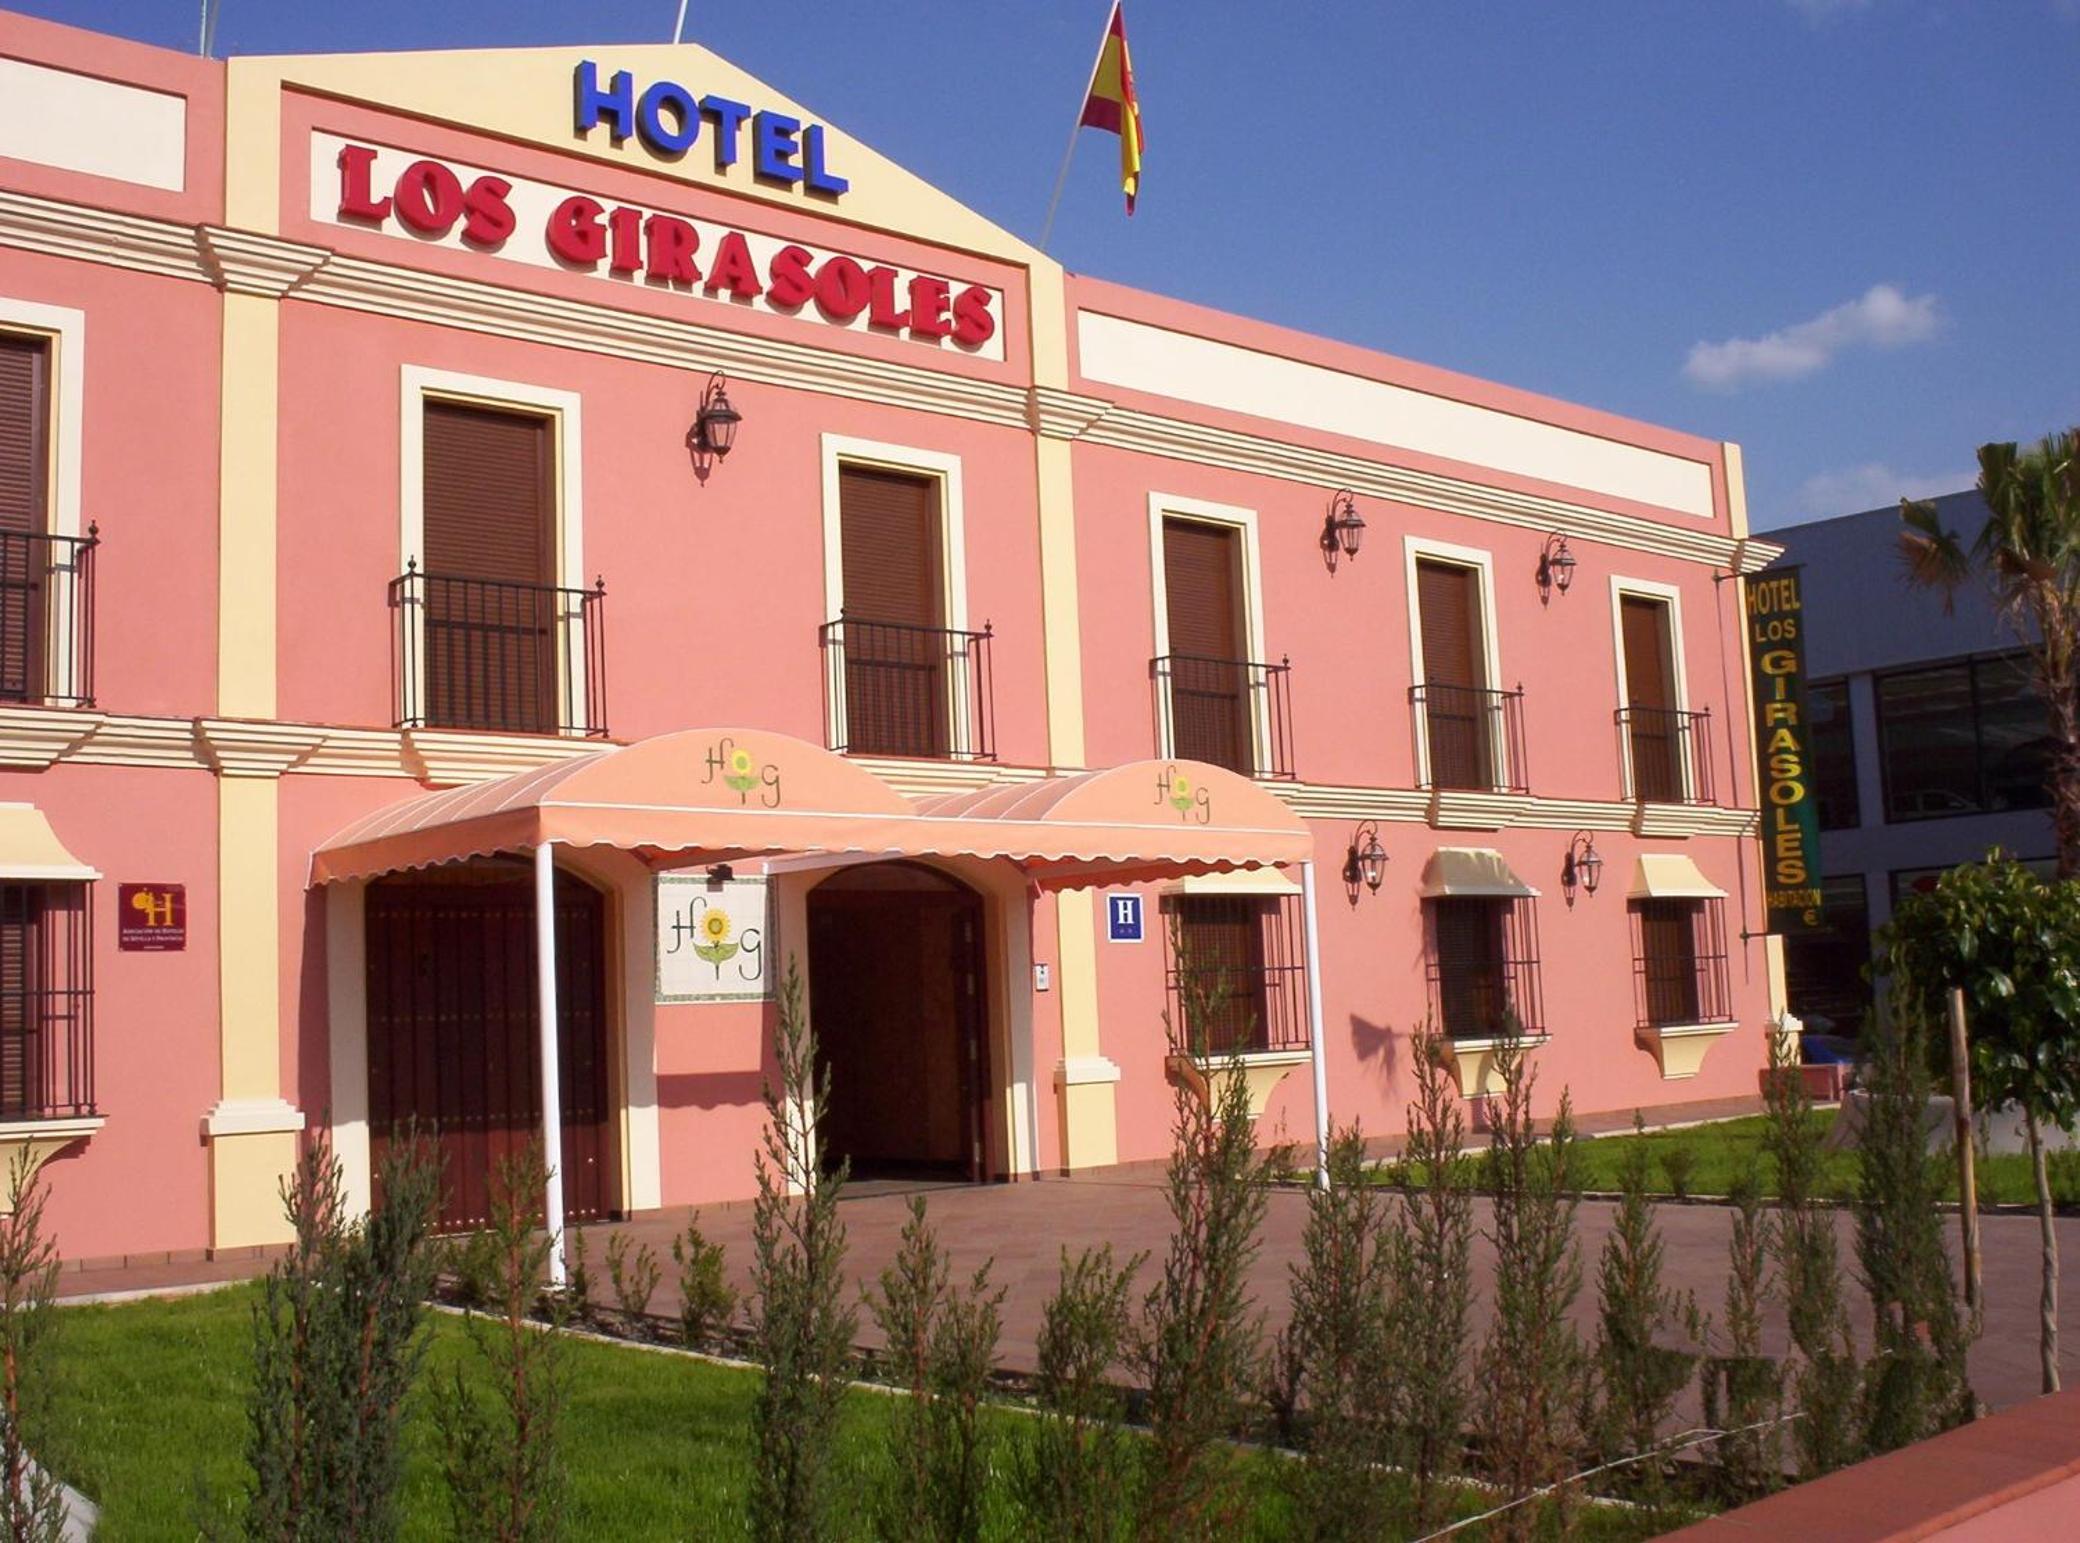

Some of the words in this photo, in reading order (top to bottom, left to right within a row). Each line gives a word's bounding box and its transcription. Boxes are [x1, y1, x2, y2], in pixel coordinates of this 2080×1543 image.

[574, 60, 849, 198] HOTEL
[337, 143, 516, 251] LOS
[545, 195, 995, 349] GIRASOLES
[1745, 578, 1800, 615] HOTEL
[1755, 619, 1796, 643] LOS
[1761, 650, 1807, 885] GIRASOLES
[1116, 900, 1135, 925] H
